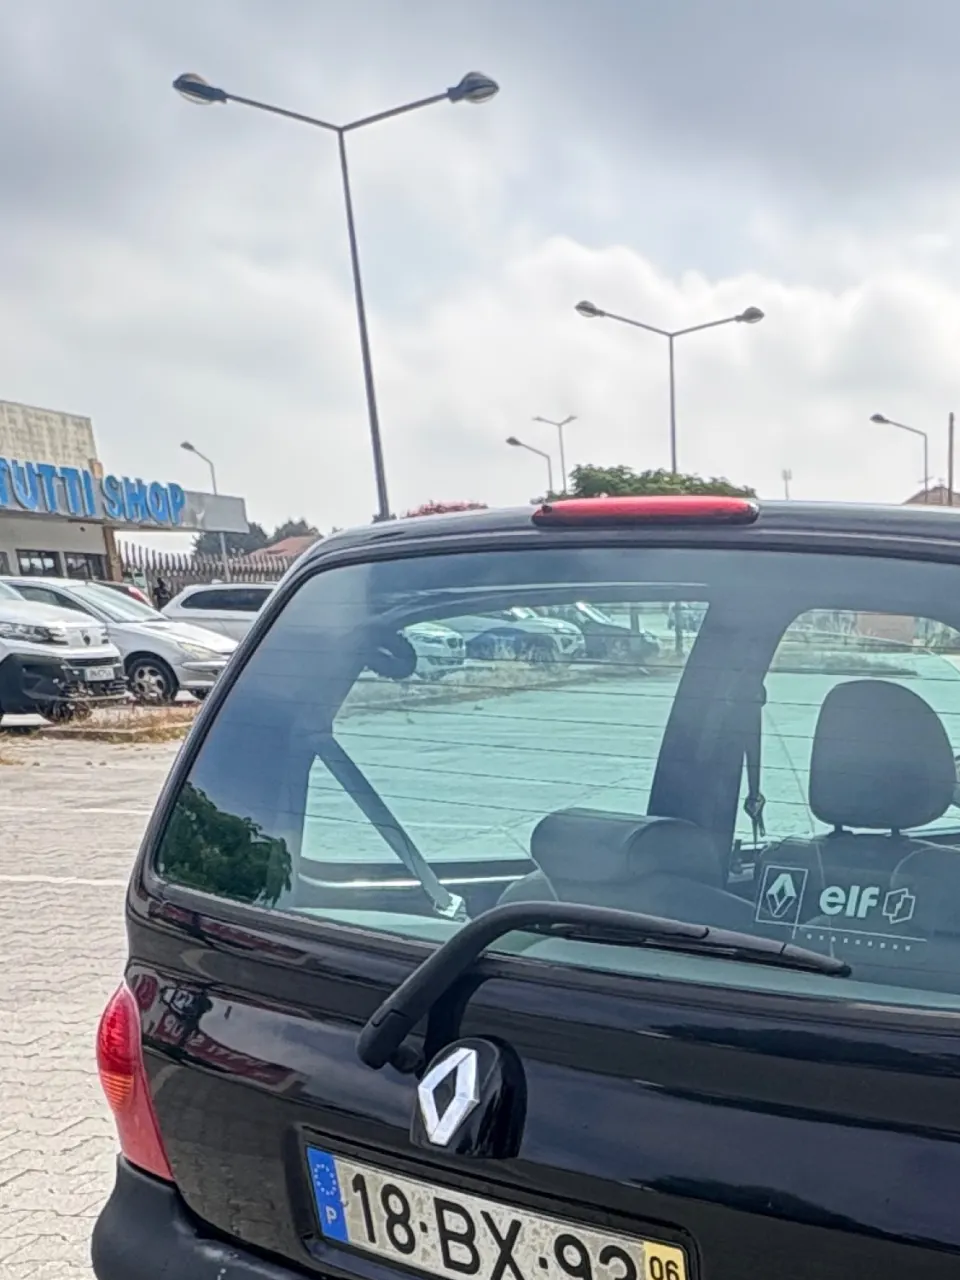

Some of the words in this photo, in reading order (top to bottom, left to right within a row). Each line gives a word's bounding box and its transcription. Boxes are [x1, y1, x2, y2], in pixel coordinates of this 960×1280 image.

[102, 475, 185, 525] SHOP
[820, 885, 880, 918] elf
[325, 1206, 337, 1225] P
